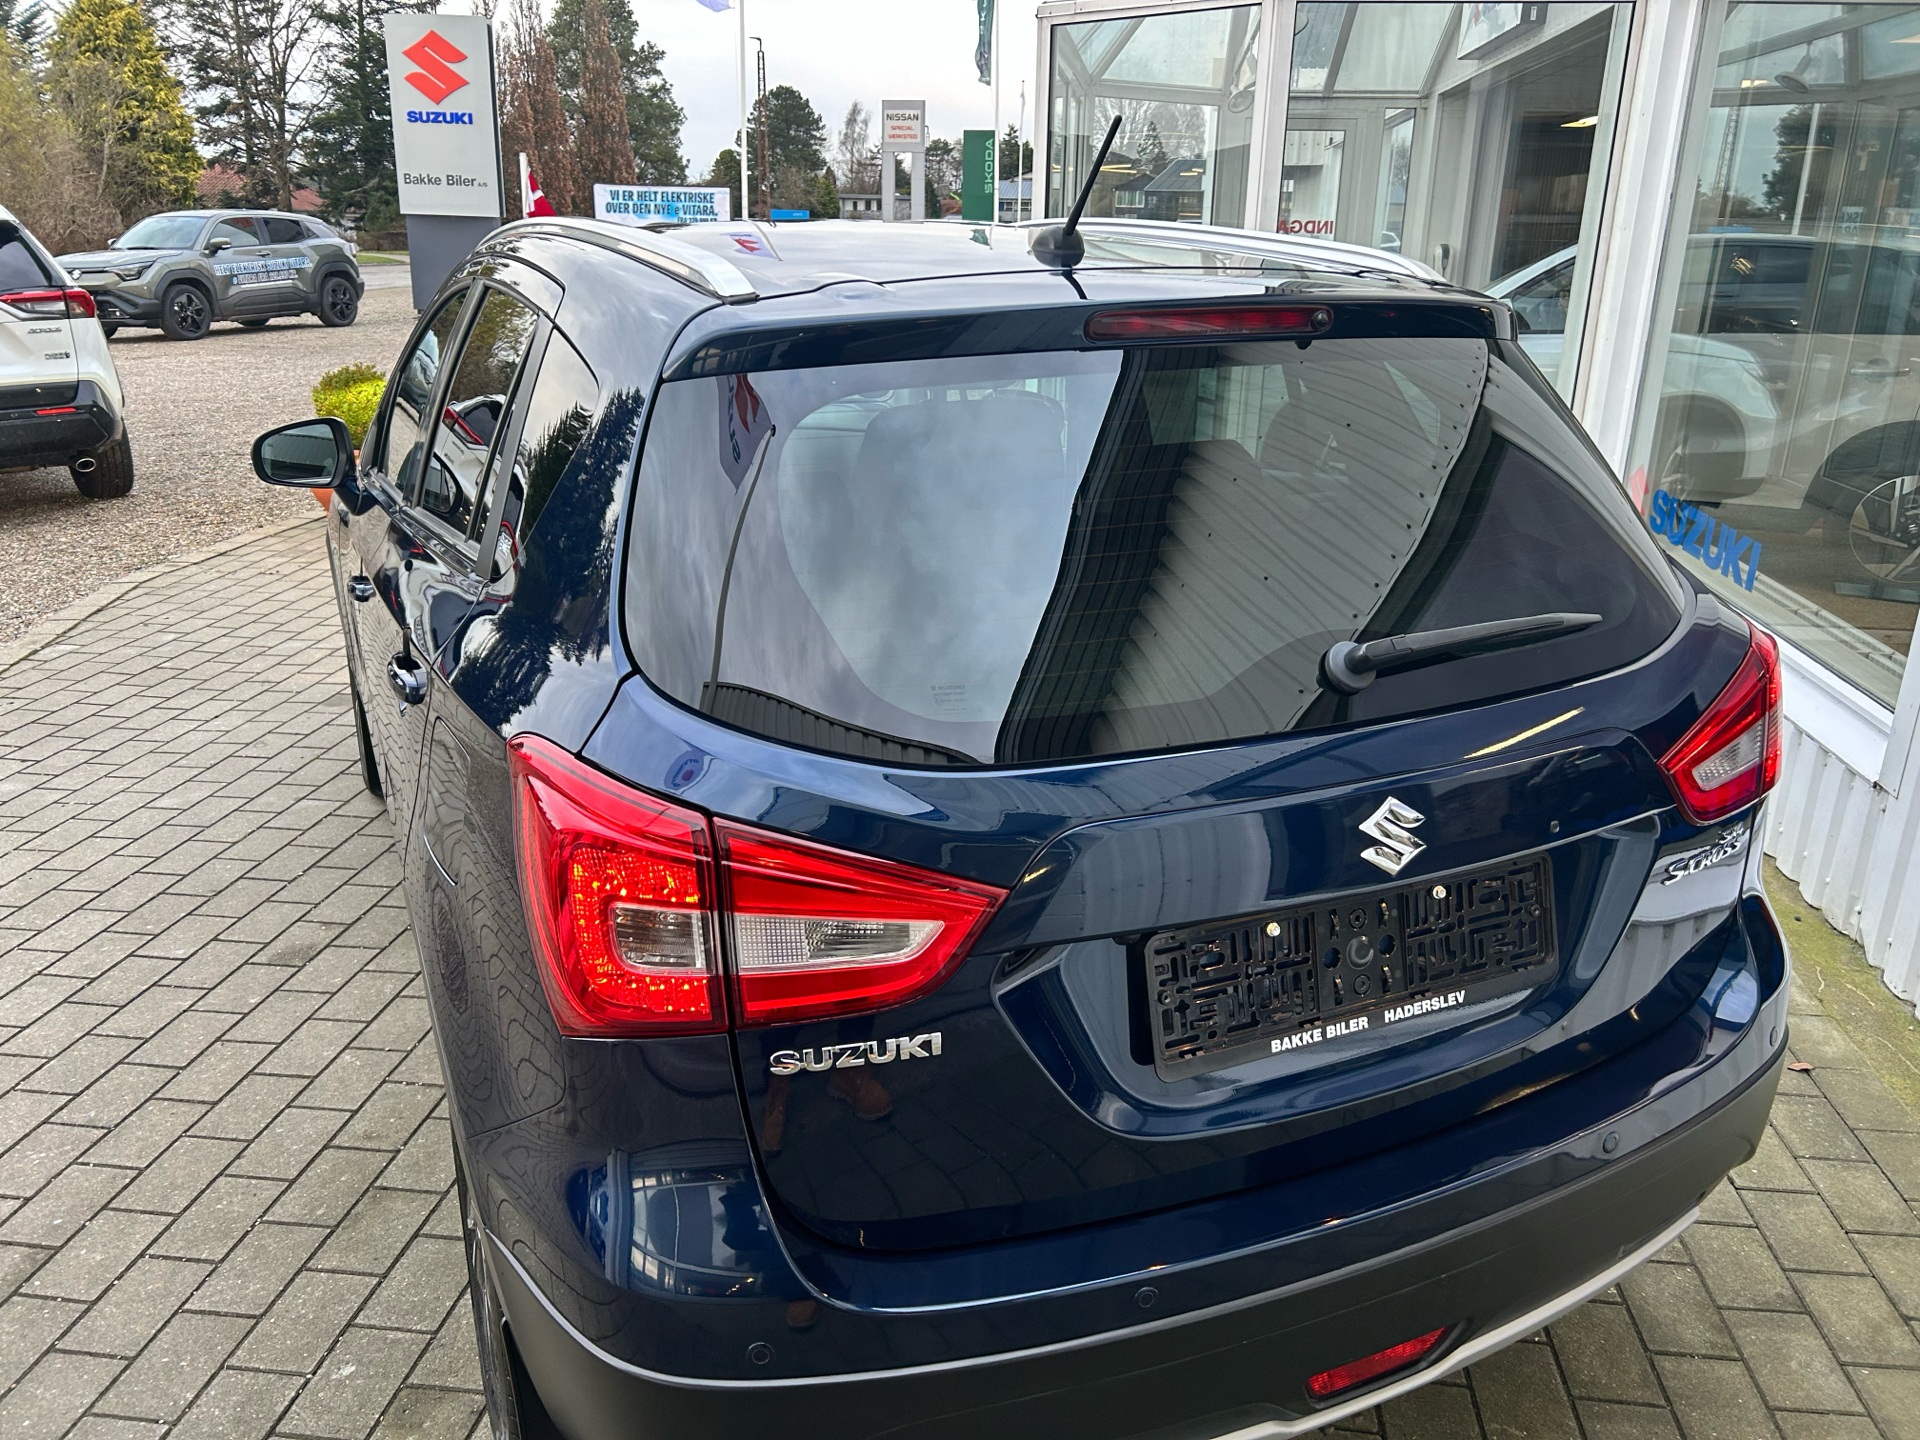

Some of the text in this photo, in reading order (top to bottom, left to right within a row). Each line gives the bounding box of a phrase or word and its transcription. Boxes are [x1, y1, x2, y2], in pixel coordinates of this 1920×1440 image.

[406, 110, 474, 125] SUZUKI
[886, 113, 919, 121] NISSAN
[403, 173, 442, 186] Bakke
[446, 174, 477, 187] Biler
[609, 189, 715, 203] VI ER HELT ELEKTRISKE
[605, 202, 631, 214] OVER
[632, 203, 651, 215] DEN
[653, 203, 672, 215] NYE
[673, 206, 680, 215] e
[1649, 488, 1762, 594] SUZUKI
[1270, 990, 1466, 1053] BAKKE BILER HADERSLEV
[769, 1031, 943, 1076] SUZUKI
